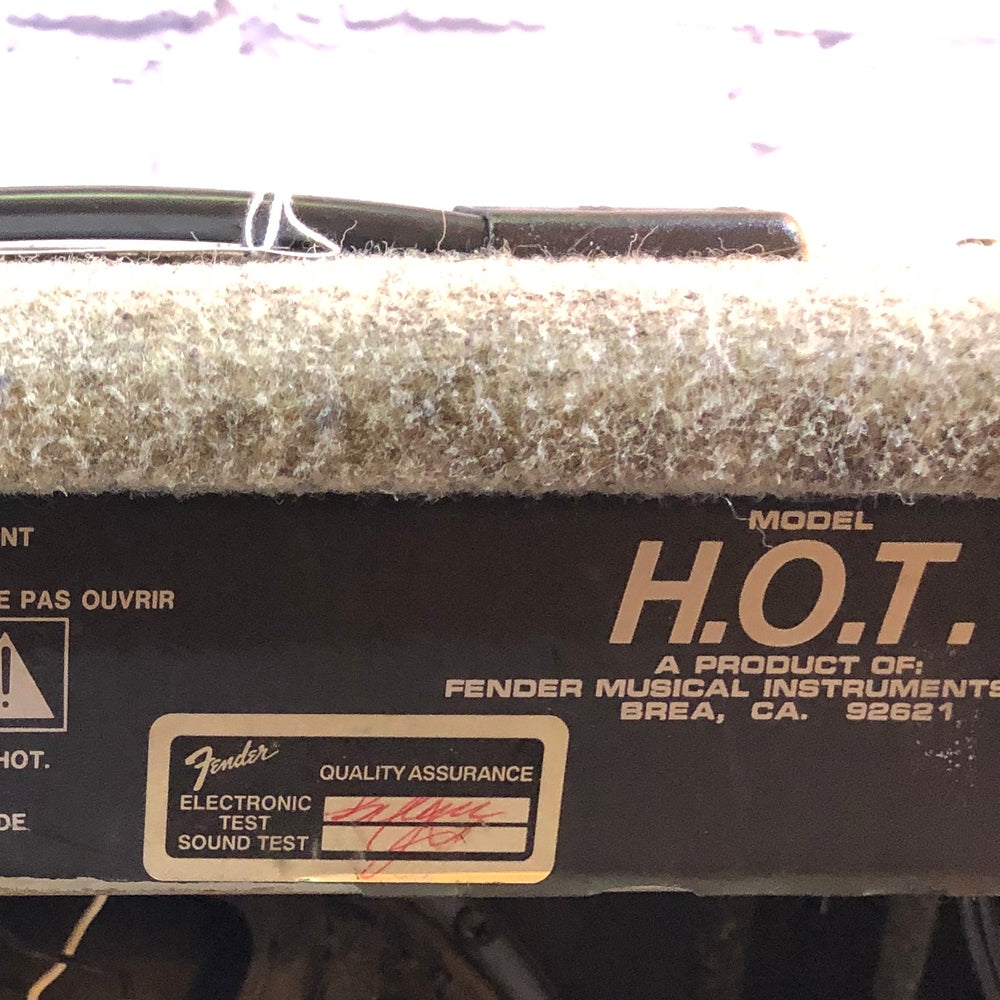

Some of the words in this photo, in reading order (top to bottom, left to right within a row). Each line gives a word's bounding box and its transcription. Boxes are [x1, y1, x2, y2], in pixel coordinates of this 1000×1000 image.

[748, 510, 874, 532] MODEL
[20, 589, 71, 610] PAS
[81, 589, 175, 611] OUVRIR
[608, 538, 976, 648] H.O.T.
[654, 655, 681, 675] A
[695, 655, 861, 676] PRODUCT
[870, 655, 924, 676] OF:
[444, 679, 583, 699] FENDER
[595, 679, 750, 699] MUSICAL
[619, 702, 726, 724] BREA,
[750, 702, 809, 721] CA.
[845, 702, 953, 721] 92621
[185, 740, 280, 792] Fender
[320, 764, 406, 782] QUALITY
[408, 765, 534, 783] ASSURANCE
[180, 795, 312, 811] ELECTRONIC
[219, 815, 271, 831] TEST
[178, 835, 251, 851] SOUND
[259, 835, 309, 851] TEST
